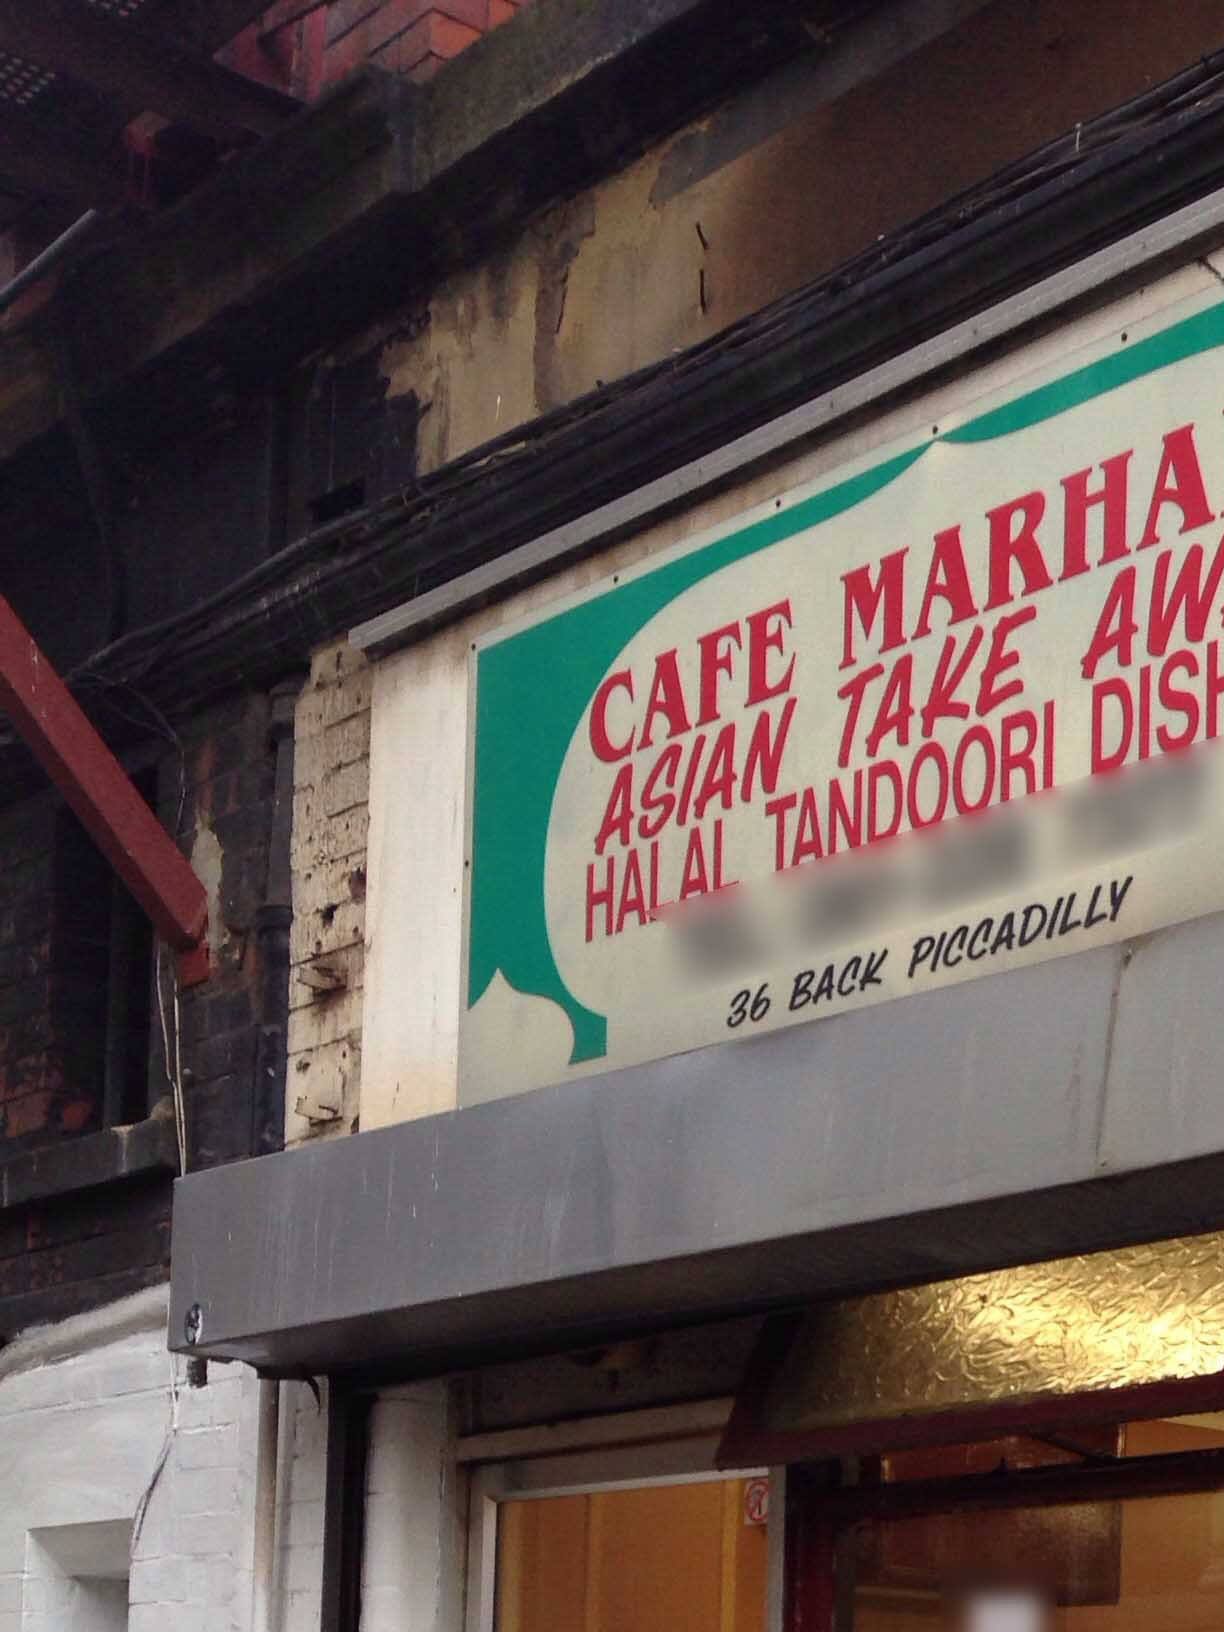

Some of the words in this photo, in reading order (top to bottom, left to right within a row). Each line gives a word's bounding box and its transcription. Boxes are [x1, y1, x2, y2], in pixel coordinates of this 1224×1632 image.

[588, 600, 797, 763] CAFE
[595, 697, 798, 855] ASIAN
[838, 605, 1038, 768] TAKE
[585, 819, 739, 942] HALAL
[765, 700, 1056, 872] TANDOORI
[727, 983, 771, 1029] 36
[789, 948, 889, 1012] BACK
[907, 876, 1134, 979] PICCADILLY
